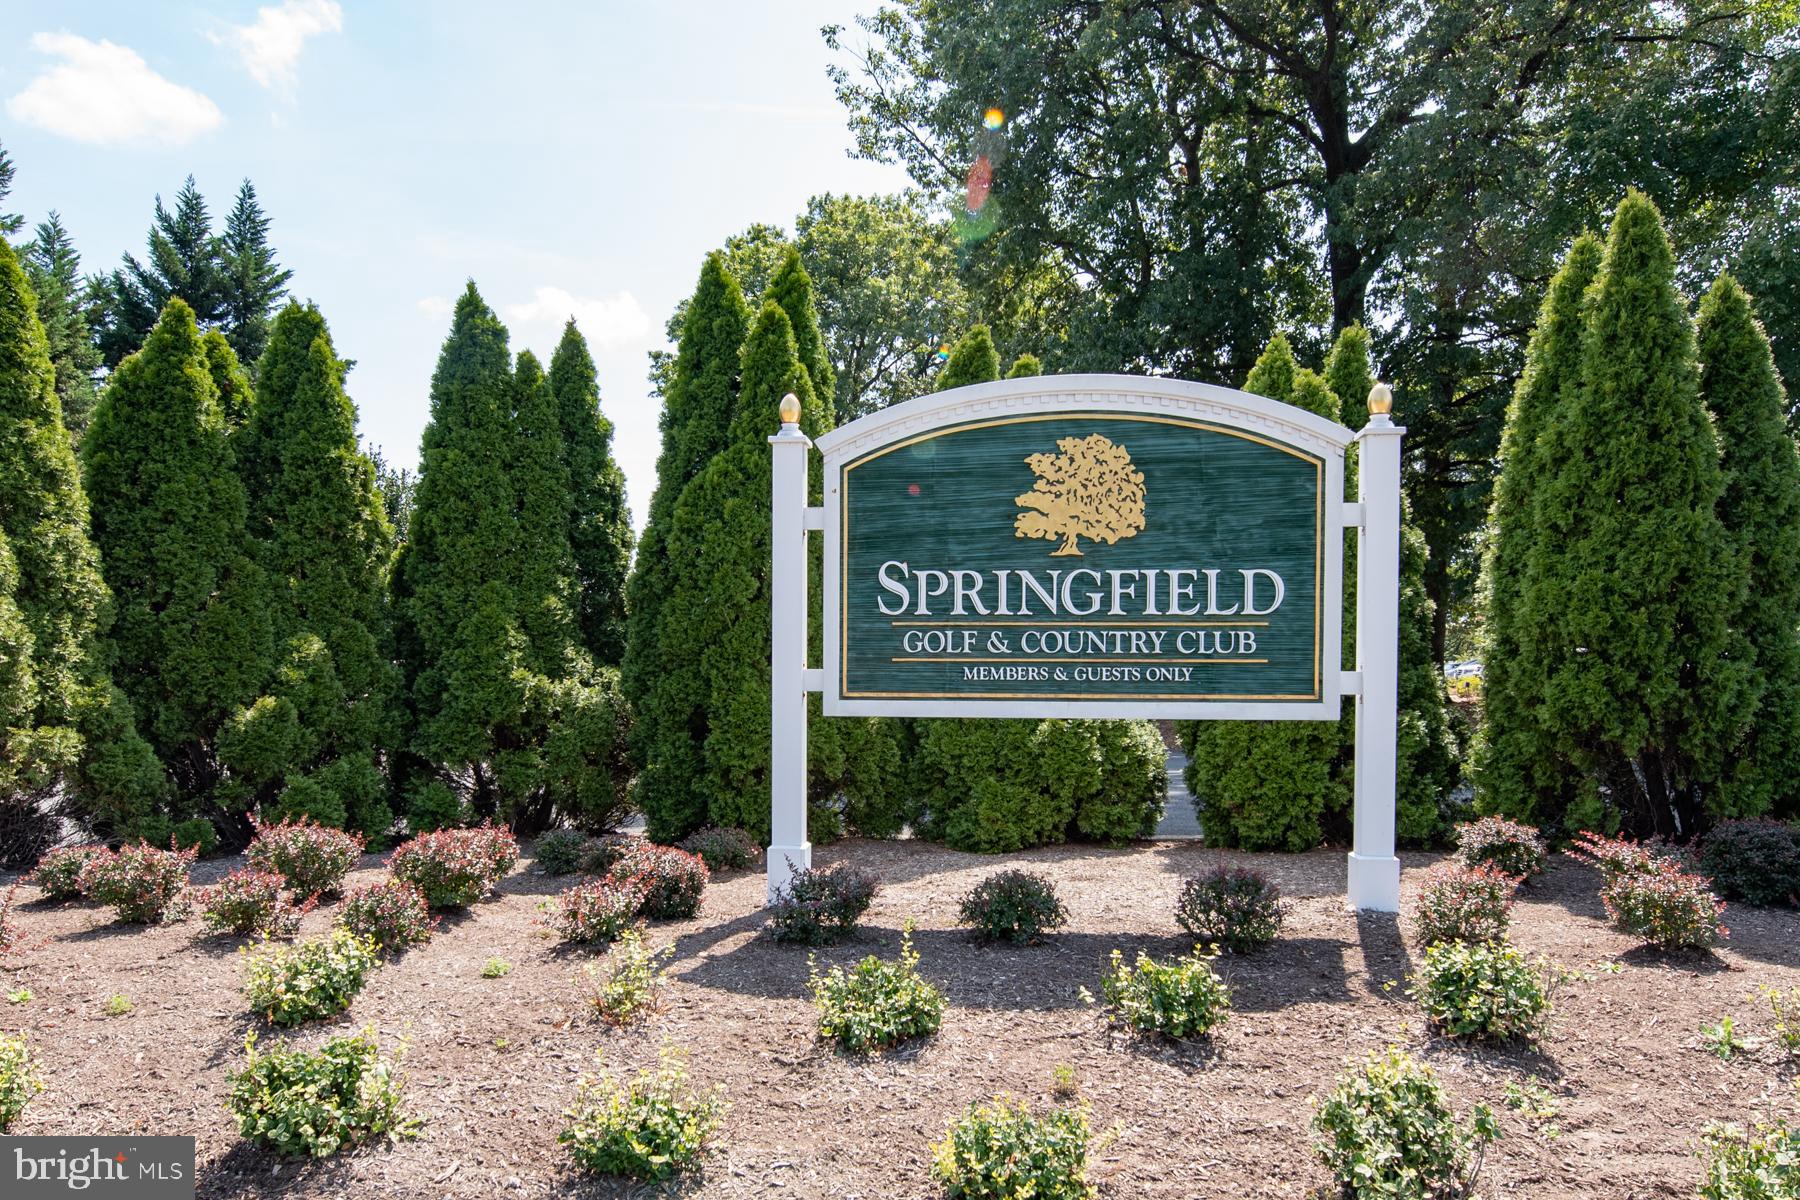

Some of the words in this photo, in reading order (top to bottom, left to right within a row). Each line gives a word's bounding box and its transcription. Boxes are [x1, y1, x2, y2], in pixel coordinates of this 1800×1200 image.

[877, 560, 1285, 616] SPRINGFIELD
[902, 630, 978, 654] GOLF
[986, 630, 1013, 654] &
[1020, 630, 1168, 654] COUNTRY
[1176, 630, 1257, 654] CLUB
[962, 666, 1049, 681] MEMBERS
[1053, 666, 1070, 681] &
[1074, 666, 1141, 682] GUESTS
[1145, 667, 1194, 682] ONLY
